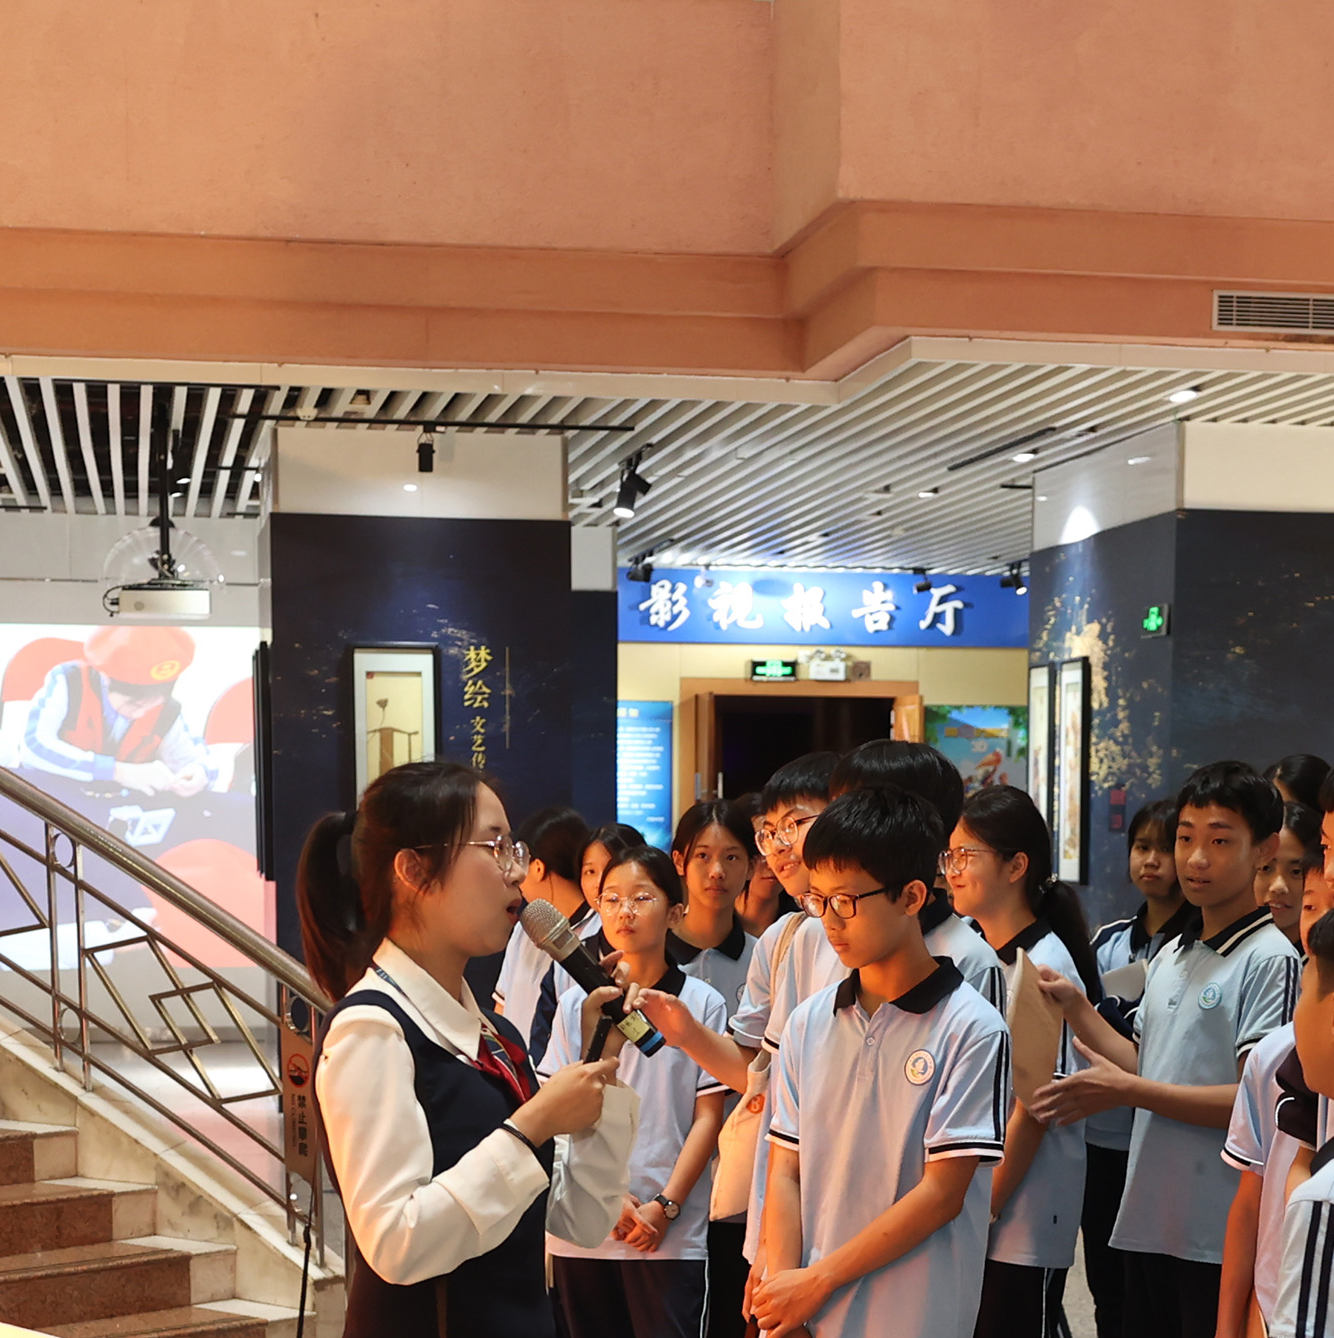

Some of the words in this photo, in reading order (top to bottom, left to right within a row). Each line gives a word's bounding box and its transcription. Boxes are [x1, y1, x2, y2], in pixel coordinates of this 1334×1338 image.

[639, 579, 965, 637] 影视报告厅
[462, 645, 494, 708] 梦绘
